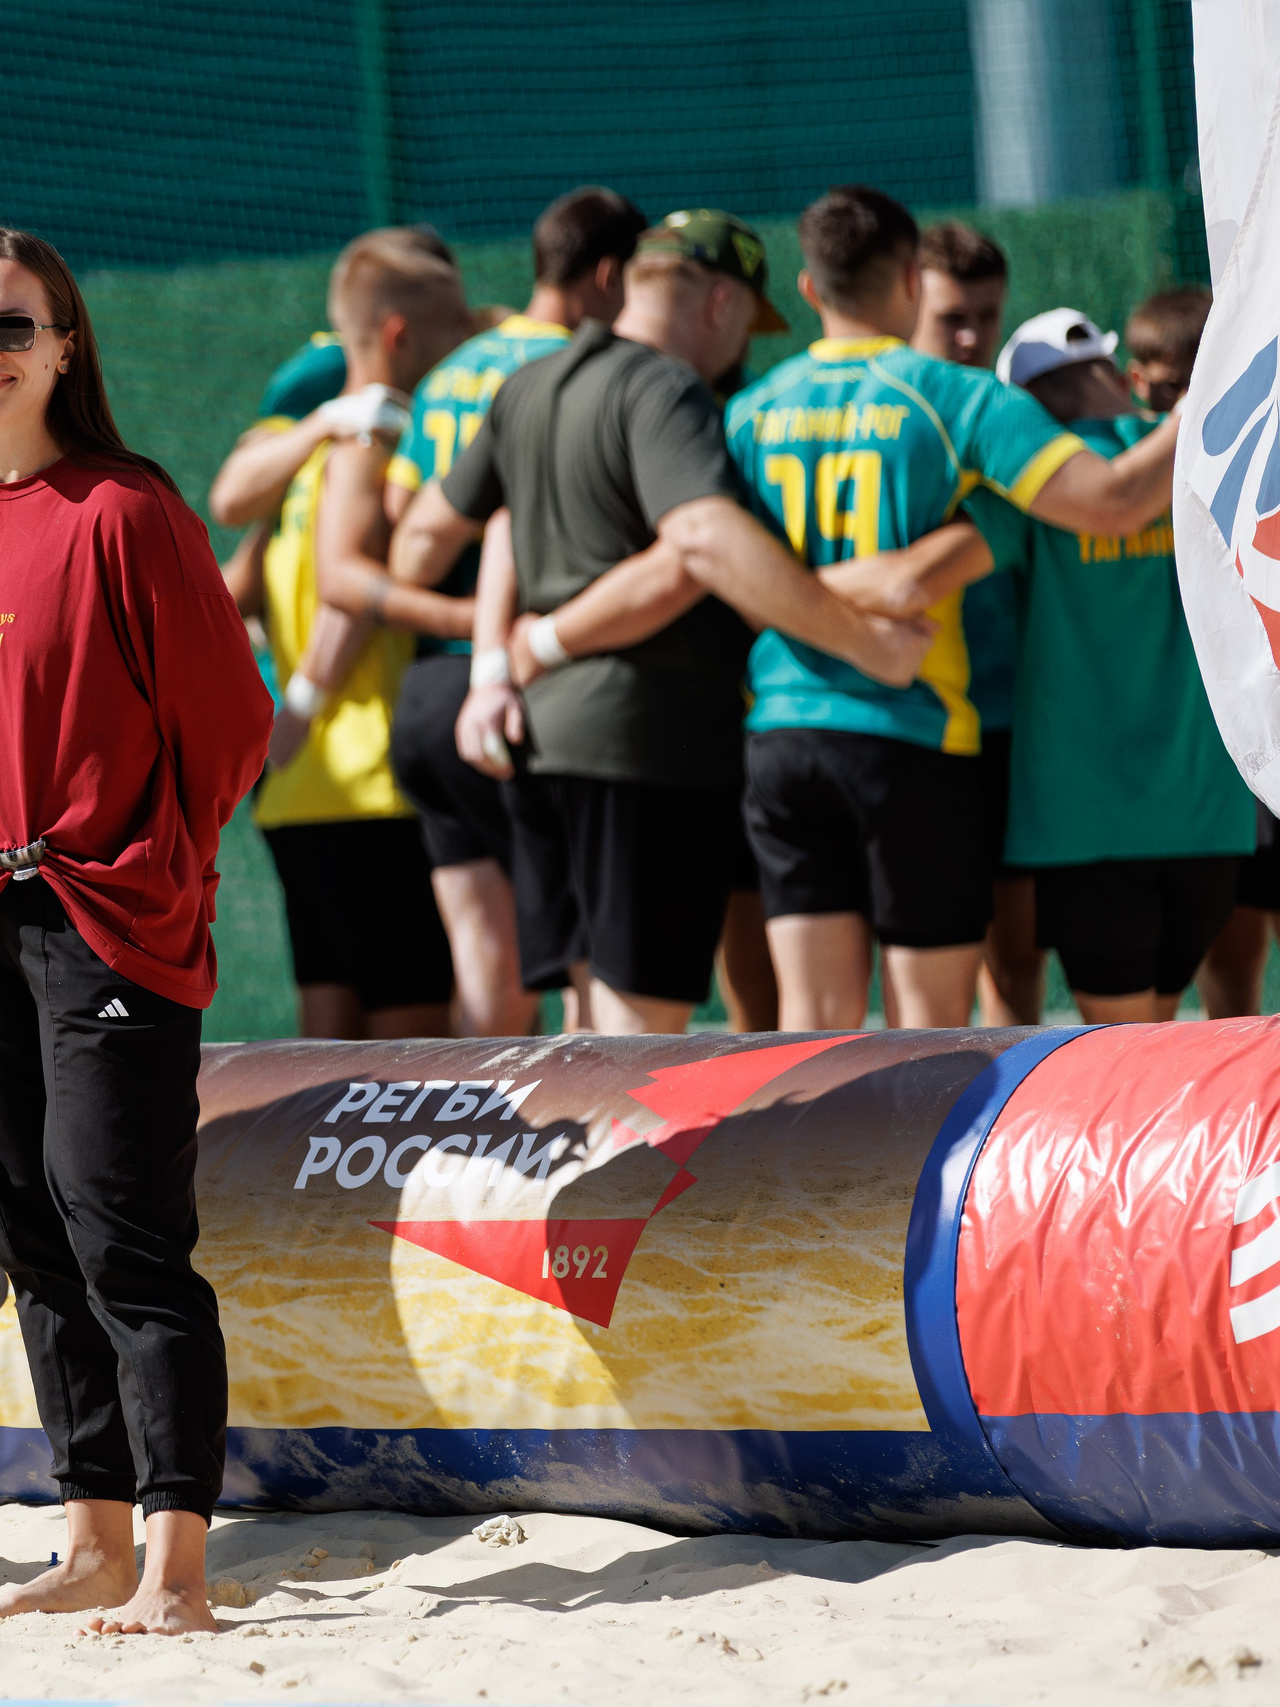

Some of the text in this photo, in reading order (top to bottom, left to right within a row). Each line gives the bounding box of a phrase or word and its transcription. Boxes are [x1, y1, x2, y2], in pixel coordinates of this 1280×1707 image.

[765, 449, 882, 560] 19
[323, 1079, 543, 1124] РЕГБИ
[293, 1132, 567, 1190] РОССИИ
[541, 1245, 608, 1279] 1892
